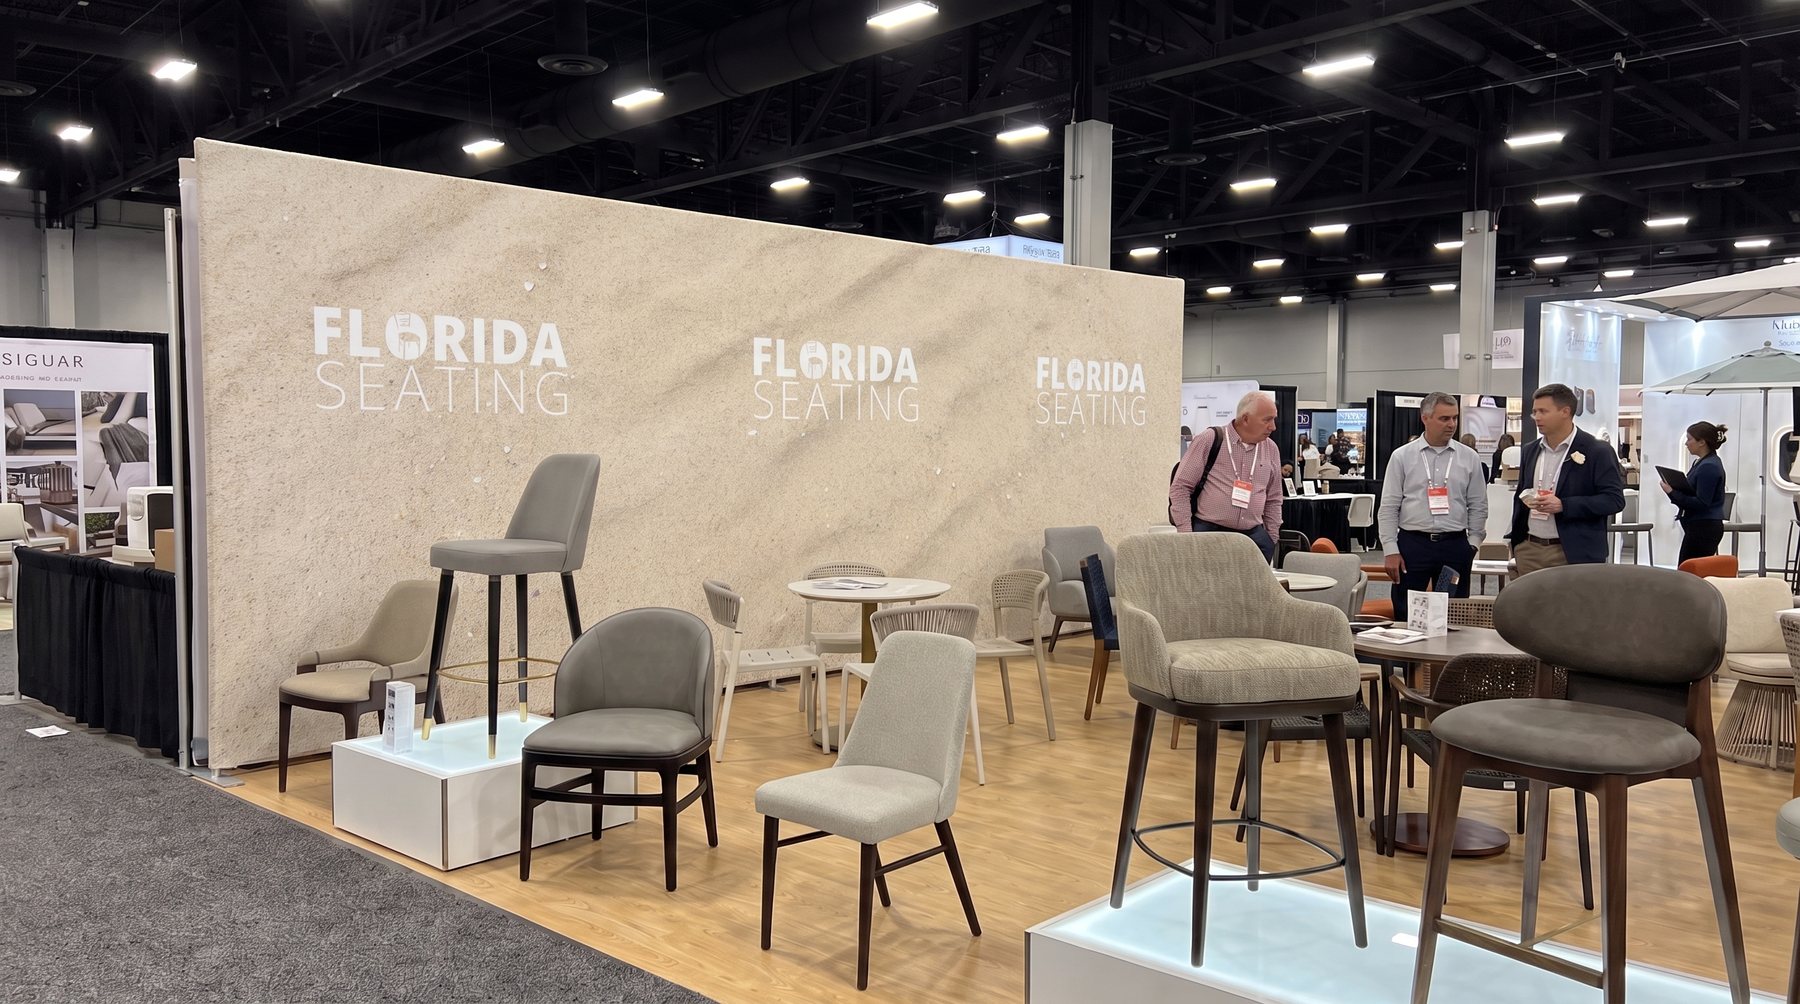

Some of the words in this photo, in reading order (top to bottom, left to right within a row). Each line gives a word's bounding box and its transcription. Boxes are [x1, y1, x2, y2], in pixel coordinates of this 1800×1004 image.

[313, 306, 568, 368] FLORIDA
[2, 352, 84, 368] SIGUAR
[753, 337, 918, 383] FLORIDA
[1036, 356, 1146, 393] FLORIDA
[315, 360, 568, 415] SEATING
[754, 379, 919, 422] SEATING
[1036, 391, 1146, 426] SEATING
